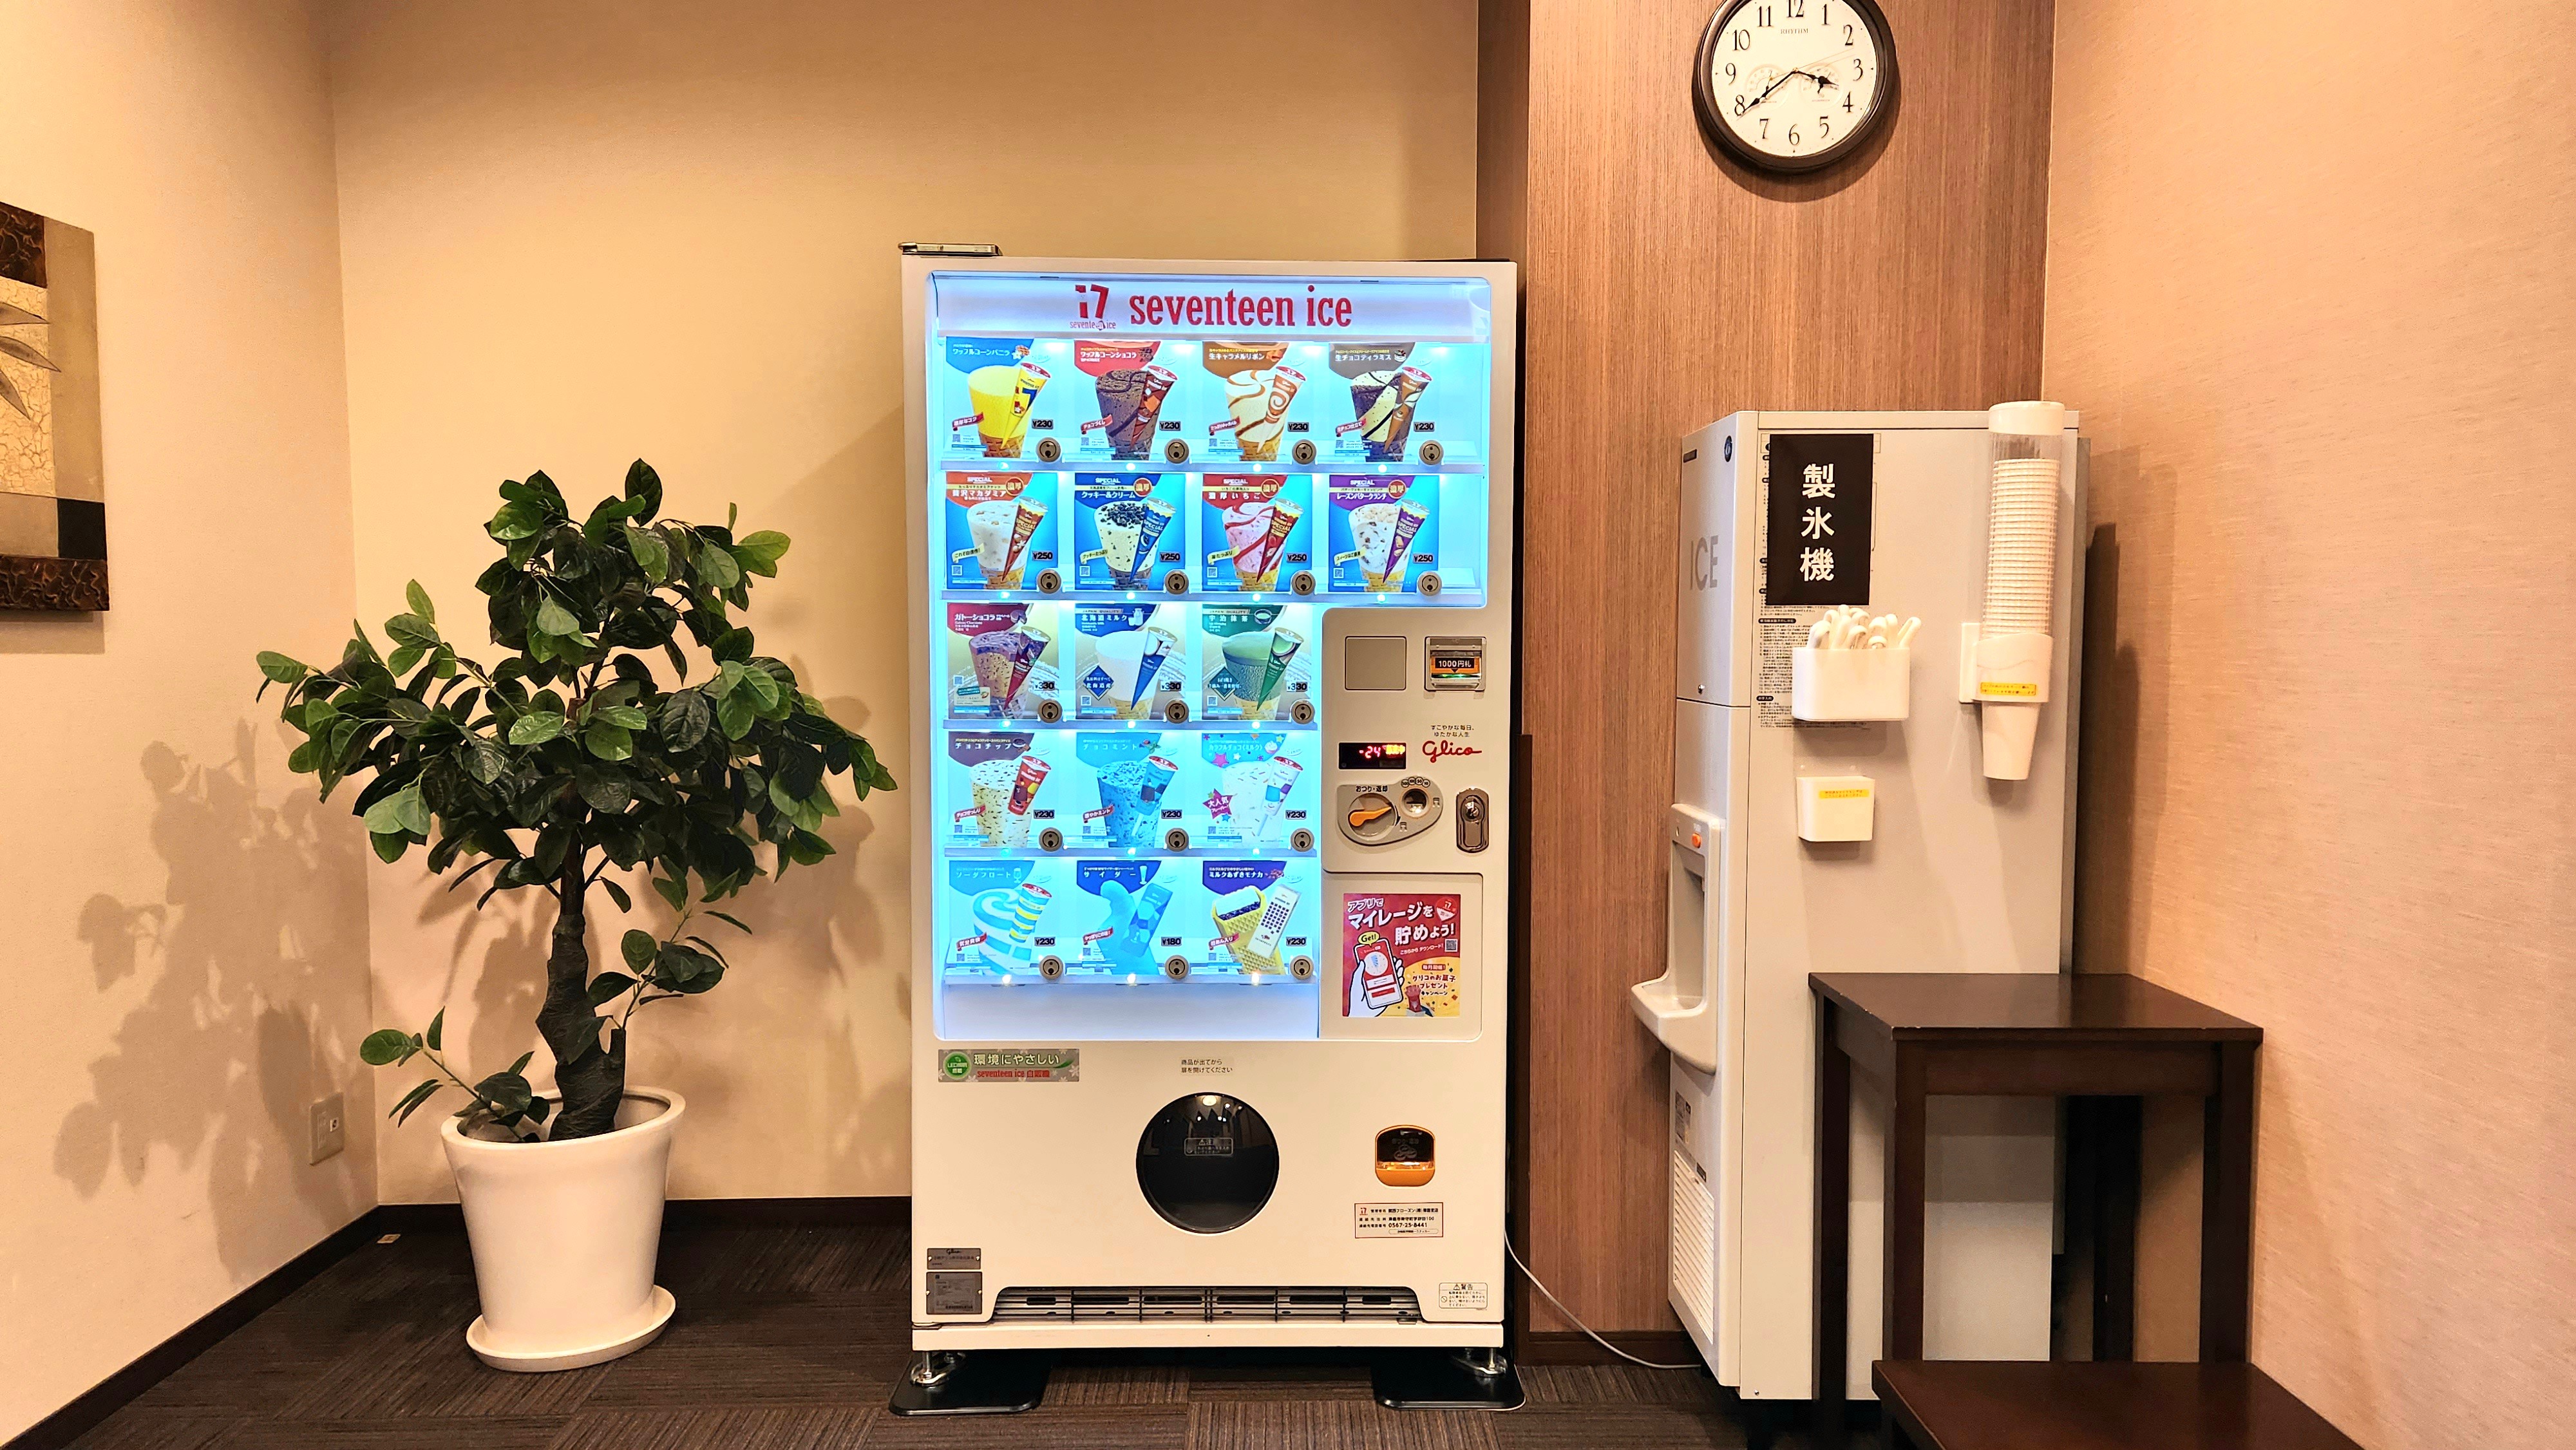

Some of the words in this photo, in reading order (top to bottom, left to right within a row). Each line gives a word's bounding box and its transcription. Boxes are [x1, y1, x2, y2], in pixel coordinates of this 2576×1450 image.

[1757, 6, 1772, 27] 11
[1786, 0, 1804, 18] 12
[1823, 4, 1830, 25] 1
[1732, 29, 1750, 51] 10
[1844, 24, 1854, 46] 2
[1725, 63, 1736, 85] 9
[1853, 59, 1864, 81] 3
[1734, 95, 1746, 117] 8
[1842, 91, 1854, 113] 4
[1759, 118, 1770, 139] 7
[1788, 124, 1800, 146] 6
[1819, 116, 1829, 138] 5
[1130, 288, 1295, 327] seventeen
[1307, 285, 1352, 327] ice
[1106, 320, 1117, 329] ice
[1799, 463, 1835, 582] 製氷機
[1690, 535, 1719, 591] ICE
[1423, 740, 1482, 763] Glico
[1347, 898, 1384, 913] アプリで
[1348, 901, 1434, 930] マイレージを
[1361, 934, 1377, 943] Get!
[1412, 974, 1456, 983] グリコのお菓子
[974, 1053, 1059, 1066] 環境にやさしい
[977, 1069, 1012, 1078] seventeen
[1014, 1069, 1025, 1077] ice
[1027, 1069, 1050, 1078] 自販機
